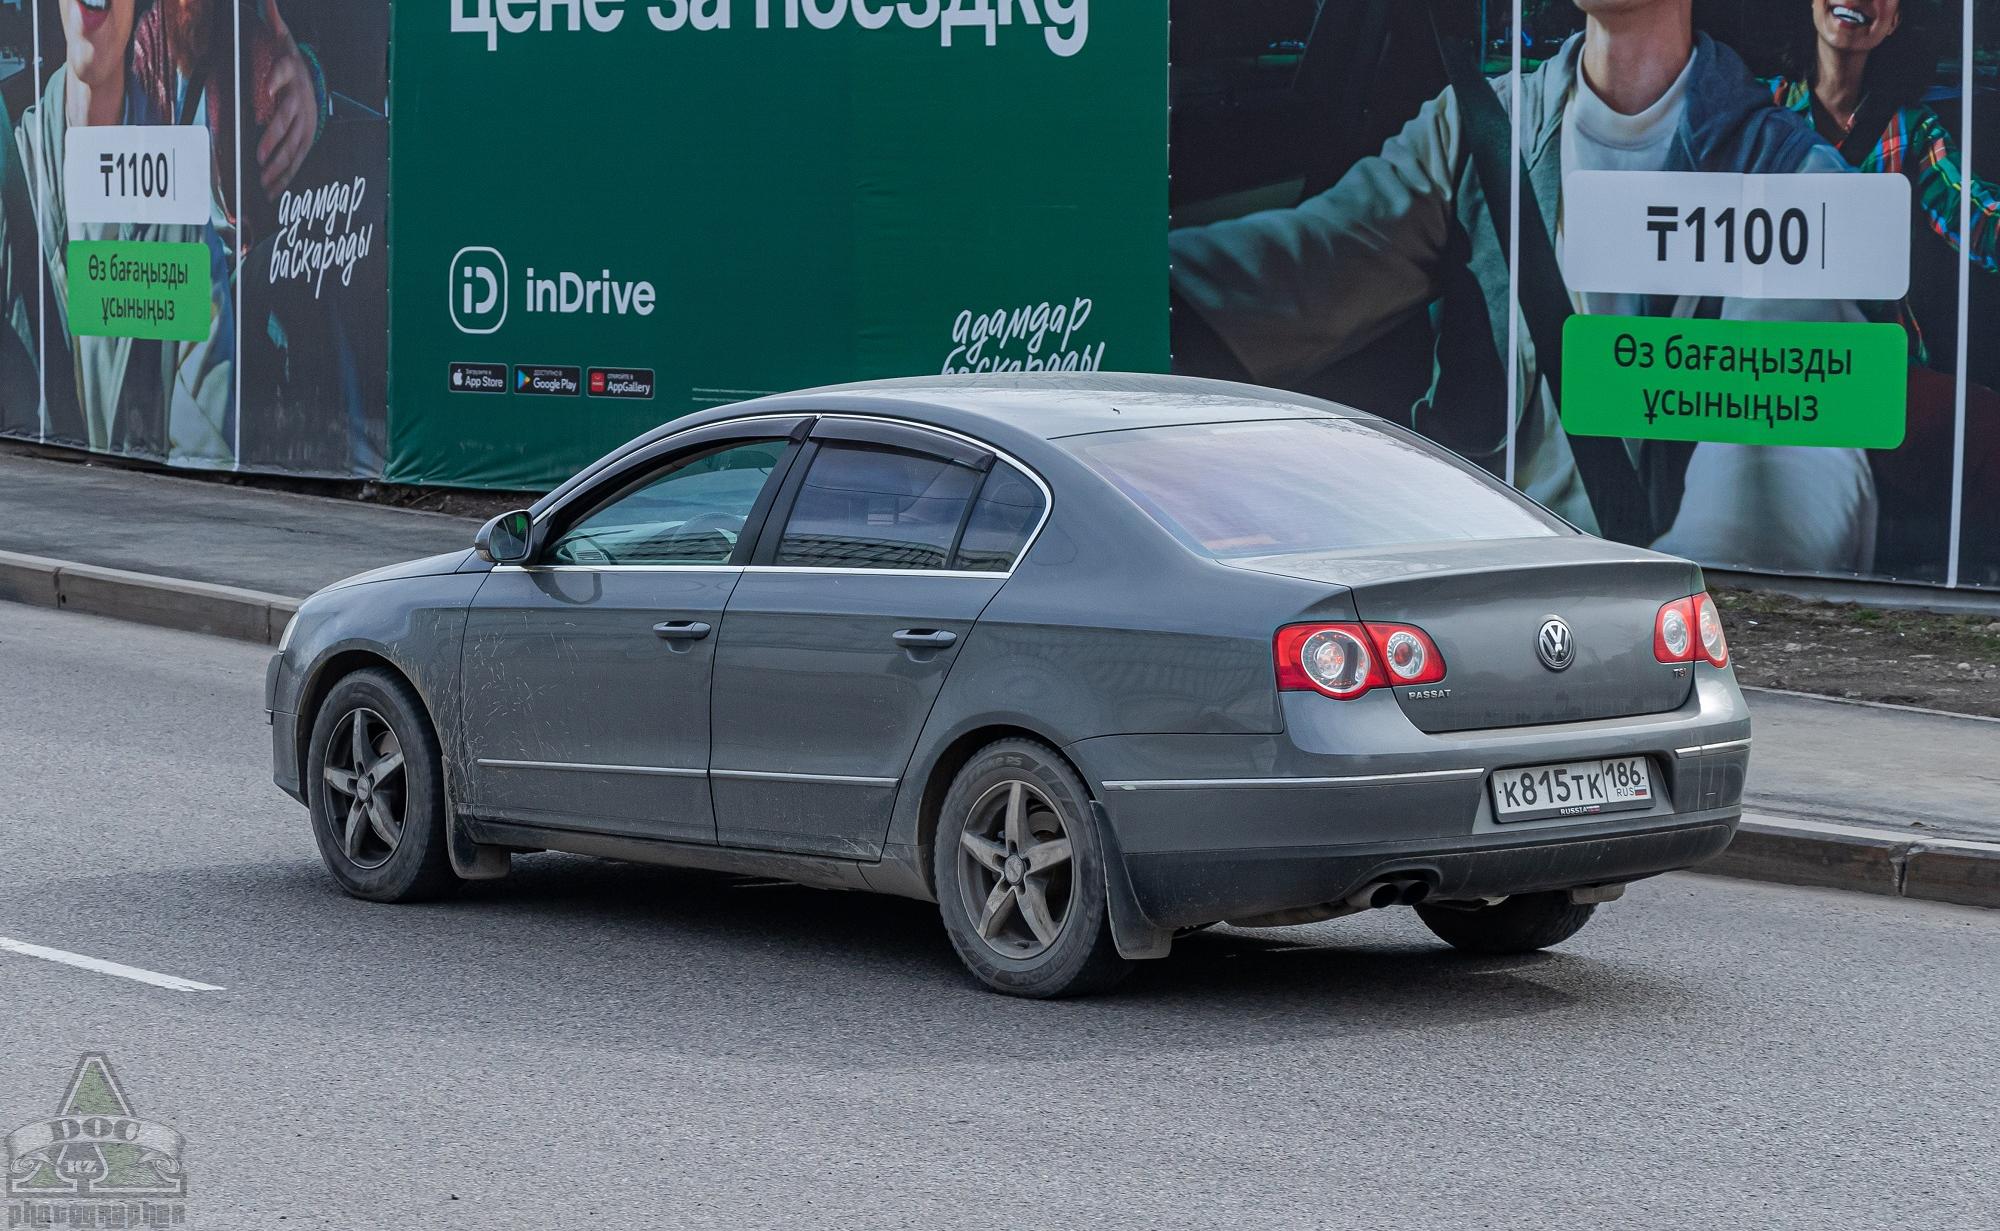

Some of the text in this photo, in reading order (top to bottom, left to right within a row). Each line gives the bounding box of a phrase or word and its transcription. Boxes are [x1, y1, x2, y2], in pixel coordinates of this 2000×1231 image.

[278, 175, 366, 248] адамдар
[88, 254, 189, 290] Өз бағаңызды
[269, 223, 373, 300] басқарады
[526, 267, 656, 316] inDrive
[101, 297, 176, 326] ұсыныңыз
[952, 296, 1092, 365] адамдар
[1613, 333, 1852, 383] Өз бағаңызды
[465, 375, 504, 389] App Store
[533, 377, 577, 393] Google Play
[607, 380, 651, 396] AppGallery
[1642, 388, 1819, 429] ұсыныңыз
[1408, 689, 1451, 700] PASSAT
[1605, 761, 1641, 788] 186
[1616, 788, 1635, 797] RUS
[1560, 806, 1588, 816] RUSSIA
